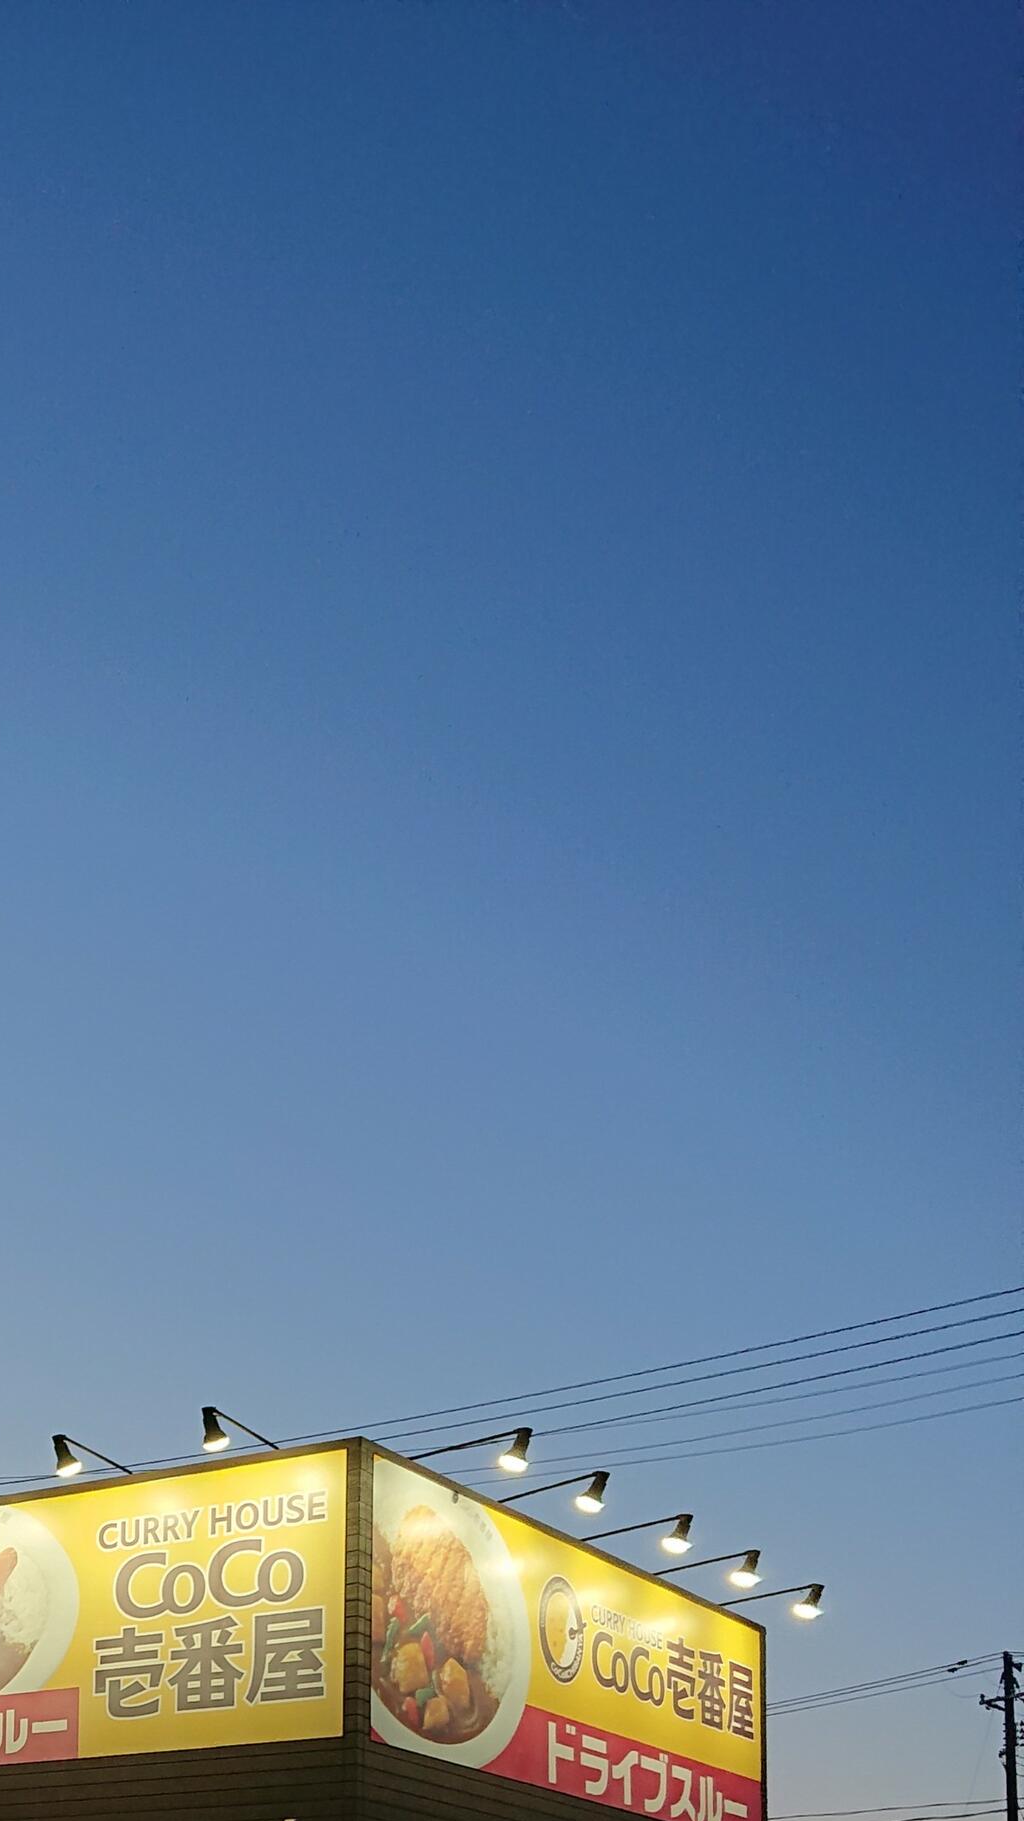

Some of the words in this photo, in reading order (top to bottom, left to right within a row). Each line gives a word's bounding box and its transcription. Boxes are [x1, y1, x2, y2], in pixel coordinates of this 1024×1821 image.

[99, 1509, 200, 1550] CURRY
[208, 1491, 327, 1536] HOUSE
[115, 1539, 305, 1619] CoCo
[591, 1605, 626, 1634] CURRY
[627, 1619, 663, 1650] HOUSE
[93, 1609, 325, 1719] 壱番屋
